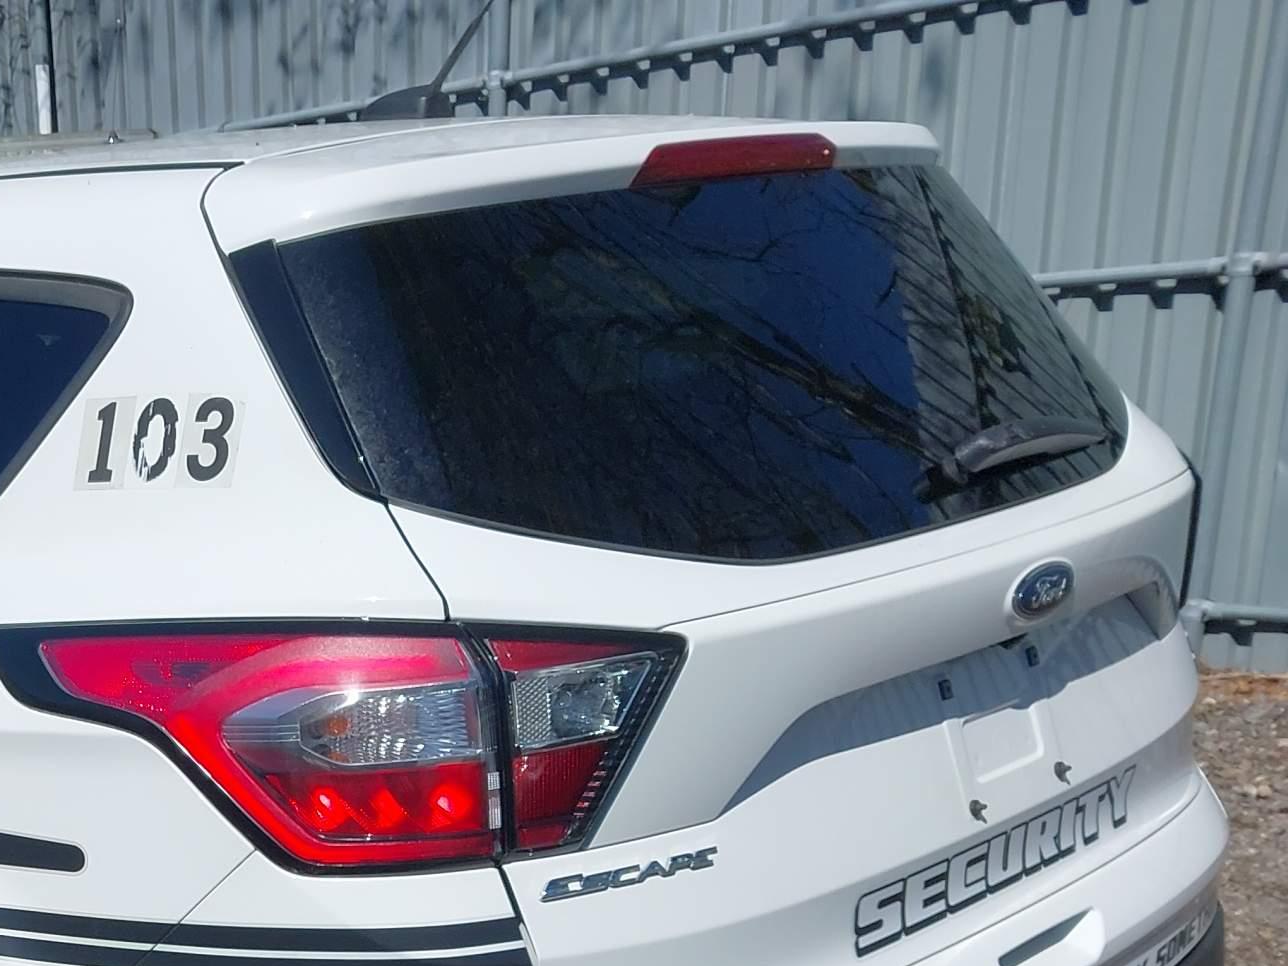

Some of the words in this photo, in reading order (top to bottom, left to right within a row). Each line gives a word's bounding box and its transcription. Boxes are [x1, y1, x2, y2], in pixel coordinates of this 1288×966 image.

[87, 397, 235, 483] 103
[541, 846, 718, 903] ESCAPE
[854, 764, 1136, 957] SECURITY
